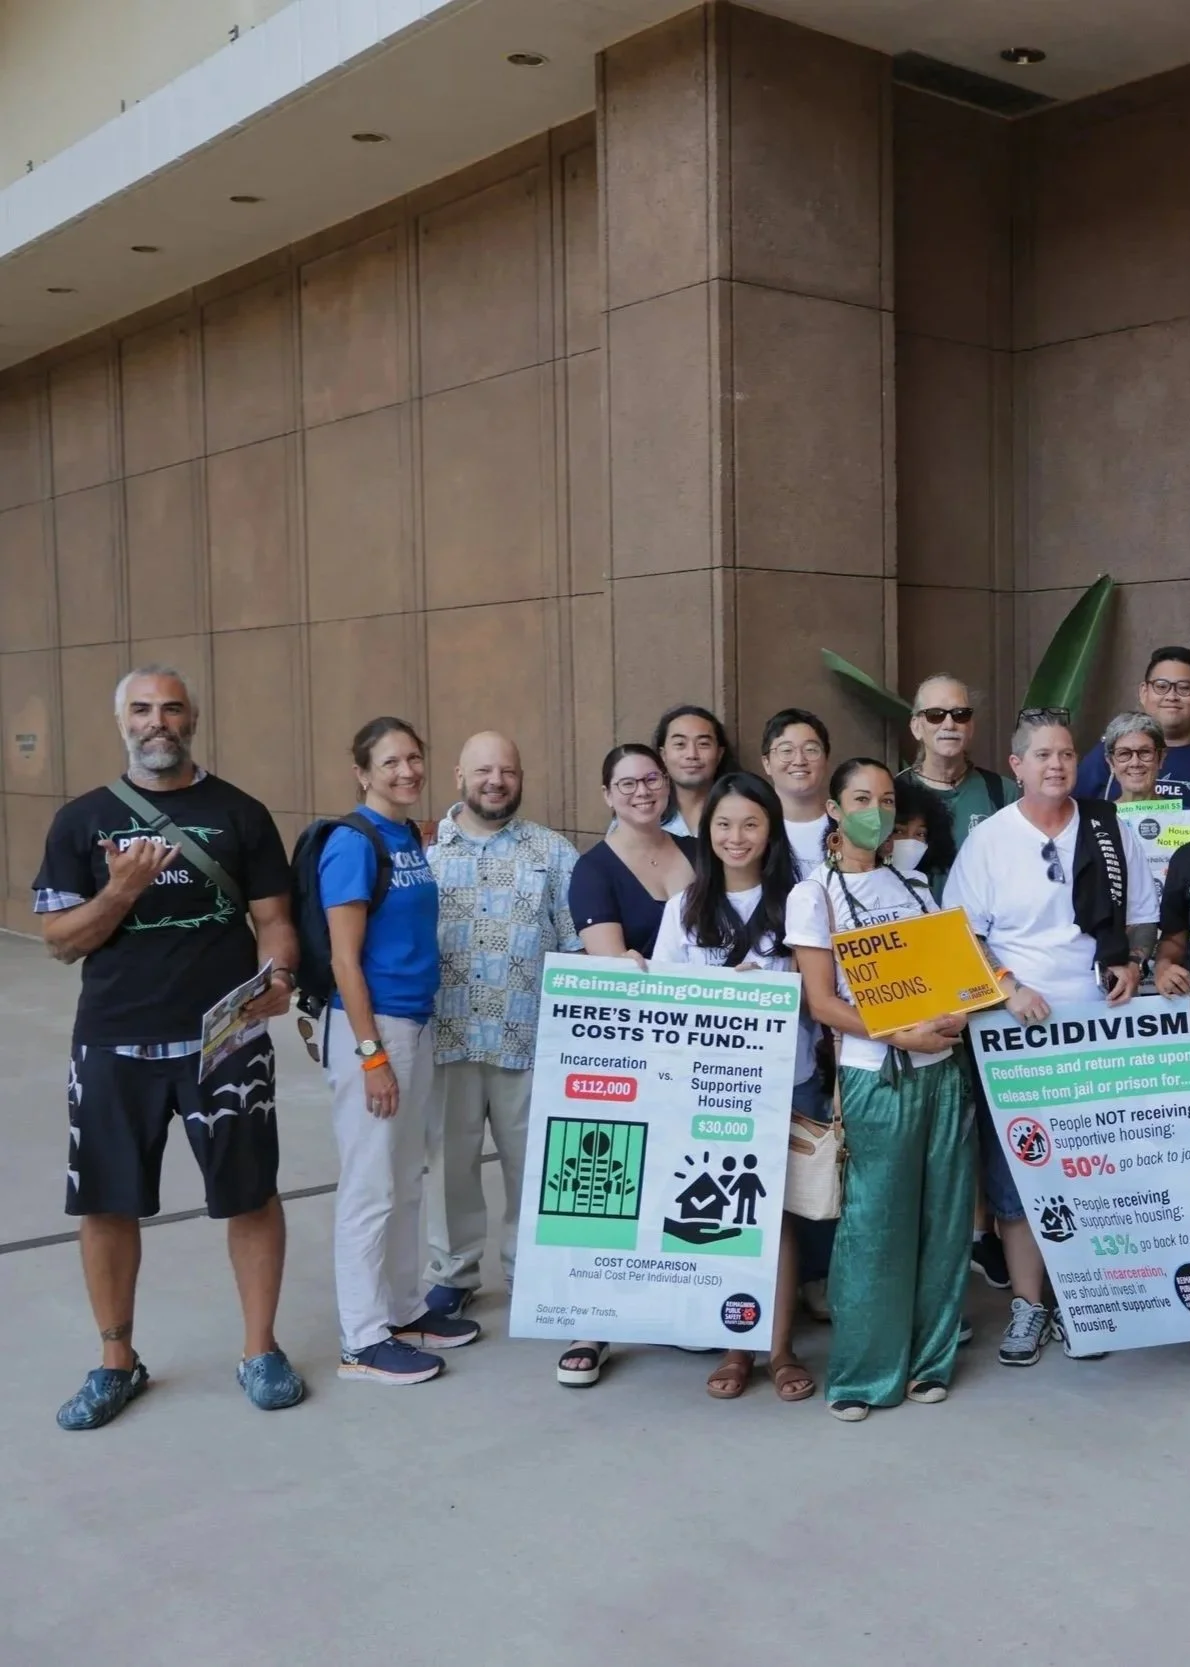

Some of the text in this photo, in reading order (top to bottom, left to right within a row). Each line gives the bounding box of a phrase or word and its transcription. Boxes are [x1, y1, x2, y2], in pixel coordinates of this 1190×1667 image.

[1155, 785, 1183, 796] OPLE.
[709, 947, 729, 960] NO
[836, 931, 908, 961] PEOPLE.
[845, 961, 880, 985] NOT
[552, 973, 793, 1007] #ReimaginingOurBudget
[855, 976, 932, 1008] PRISONS.
[552, 1003, 787, 1033] HERE'S HOW MUCH IT
[571, 1023, 764, 1050] COSTS TO FUND...
[980, 1012, 1190, 1053] RECIDIVISM
[560, 1052, 647, 1070] Incarceration
[693, 1061, 763, 1078] Permanent
[991, 1064, 1053, 1081] Reoffense
[1056, 1059, 1081, 1074] and
[1085, 1055, 1126, 1070] return
[1130, 1053, 1155, 1067] rate
[658, 1071, 674, 1082] vs.
[691, 1078, 762, 1095] Supportive
[572, 1080, 631, 1096] $112,000
[997, 1086, 1040, 1103] release
[1042, 1085, 1071, 1100] from
[1074, 1082, 1094, 1100] jail
[1097, 1080, 1112, 1094] or
[1115, 1076, 1158, 1092] prison
[698, 1095, 752, 1112] Housing
[698, 1120, 748, 1136] $30,000
[1050, 1114, 1092, 1133] People
[1096, 1109, 1126, 1127] NOT
[1054, 1123, 1176, 1151] supportive housing:
[1061, 1154, 1116, 1178] 50%
[1119, 1157, 1133, 1172] go
[1136, 1152, 1164, 1167] back
[1167, 1150, 1179, 1163] to
[1073, 1189, 1171, 1213] People receiving
[1080, 1206, 1185, 1229] supportive housing:
[1090, 1233, 1139, 1256] 13%
[1140, 1239, 1152, 1253] go
[1153, 1234, 1177, 1249] back
[1178, 1233, 1189, 1245] to
[594, 1257, 697, 1272] COST COMPARISON
[1056, 1265, 1168, 1284] Instead of incarceration,
[569, 1267, 723, 1287] Annual Cost Per Individual (USD)
[1062, 1281, 1148, 1300] we should invest in
[536, 1304, 569, 1314] Source:
[570, 1305, 589, 1316] Pew
[1068, 1300, 1121, 1318] permanent
[1121, 1296, 1172, 1313] supportive
[1073, 1317, 1118, 1333] housing.
